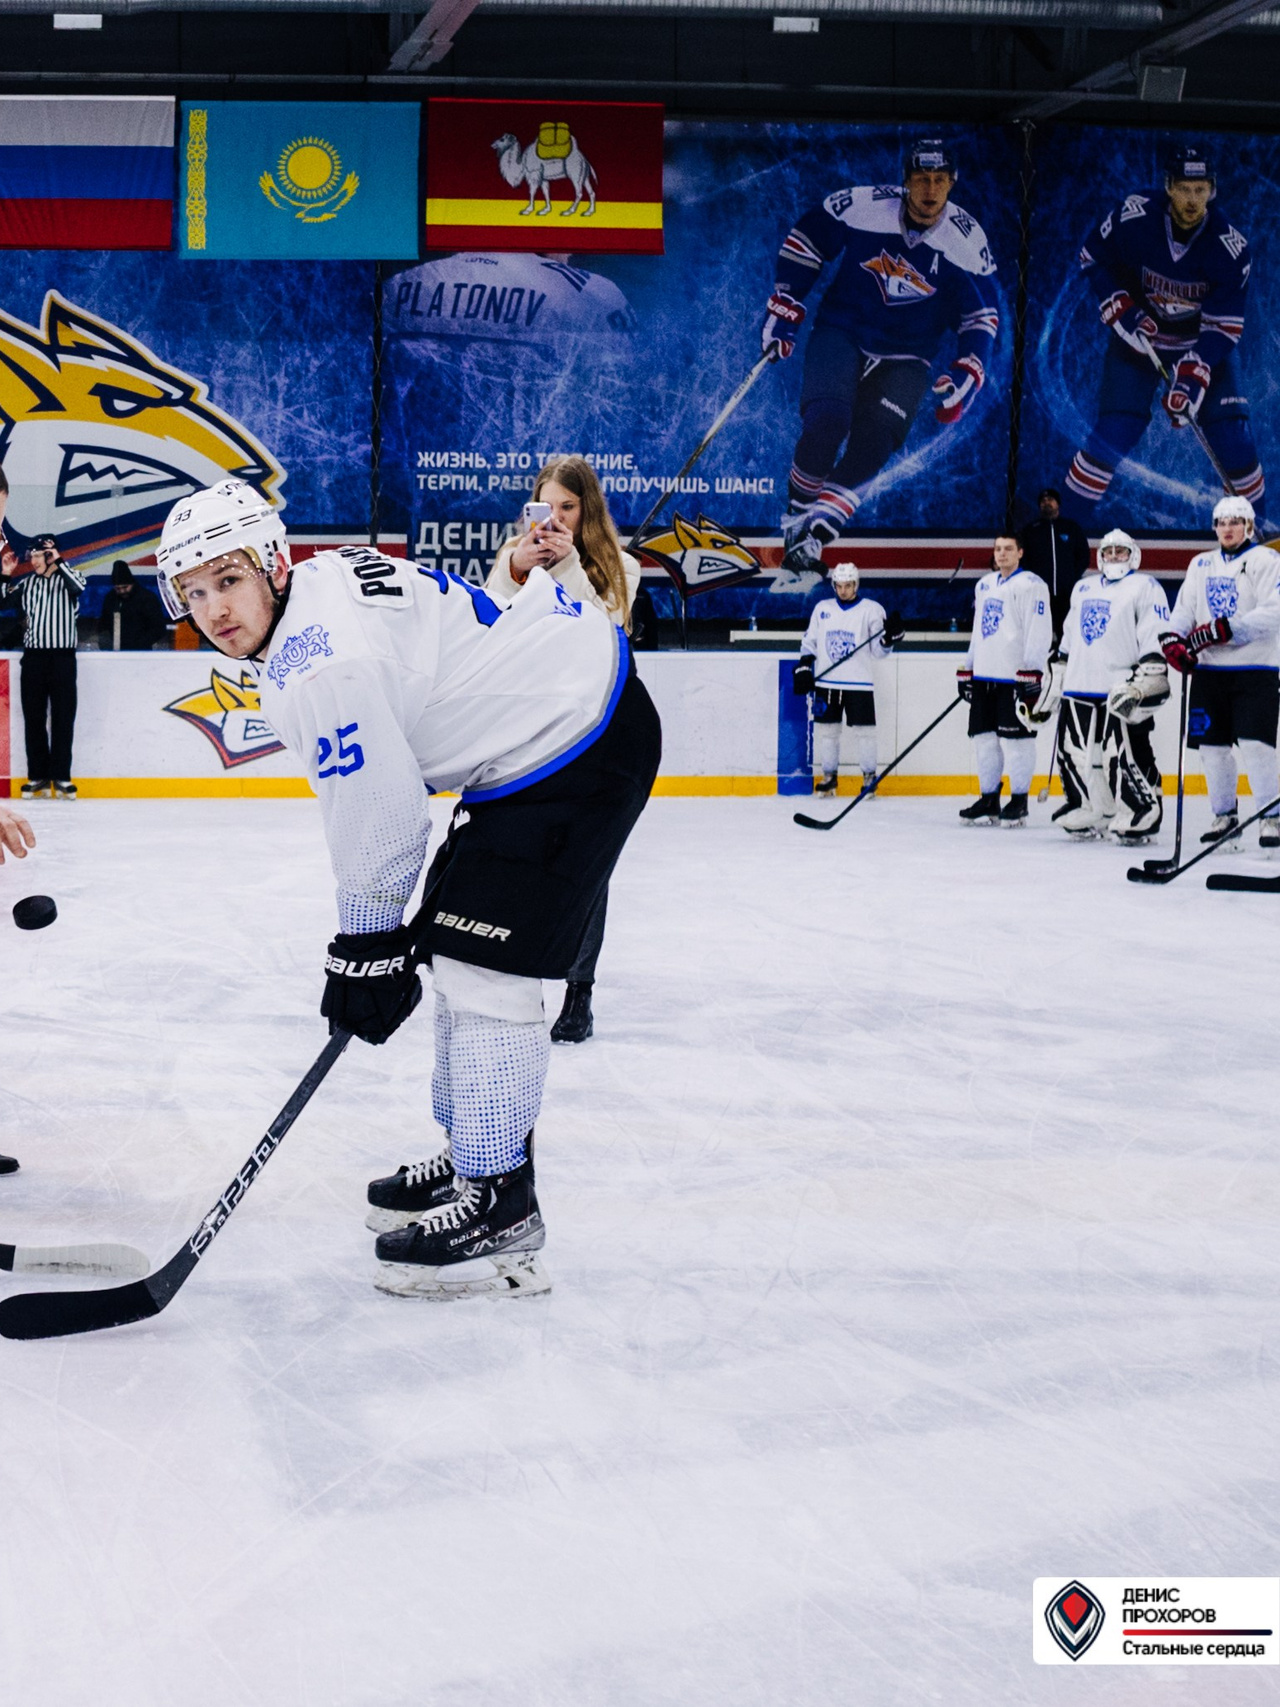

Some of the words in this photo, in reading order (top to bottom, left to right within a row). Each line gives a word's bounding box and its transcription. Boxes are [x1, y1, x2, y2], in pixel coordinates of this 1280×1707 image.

[395, 281, 547, 327] PLATONOV
[417, 451, 491, 470] ЖИЗНЬ,
[496, 452, 532, 469] ЭТО
[417, 474, 483, 492] ТЕРПИ,
[602, 476, 710, 494] ПОЛУЧИШЬ
[715, 477, 774, 495] ШАНС!
[168, 534, 201, 554] BAUER
[414, 521, 515, 555] ДЕНИ
[317, 722, 365, 779] 25
[433, 911, 512, 942] BAUER
[431, 1183, 454, 1198] BAU
[449, 1223, 490, 1247] BAUER
[462, 1211, 542, 1257] VAPOR
